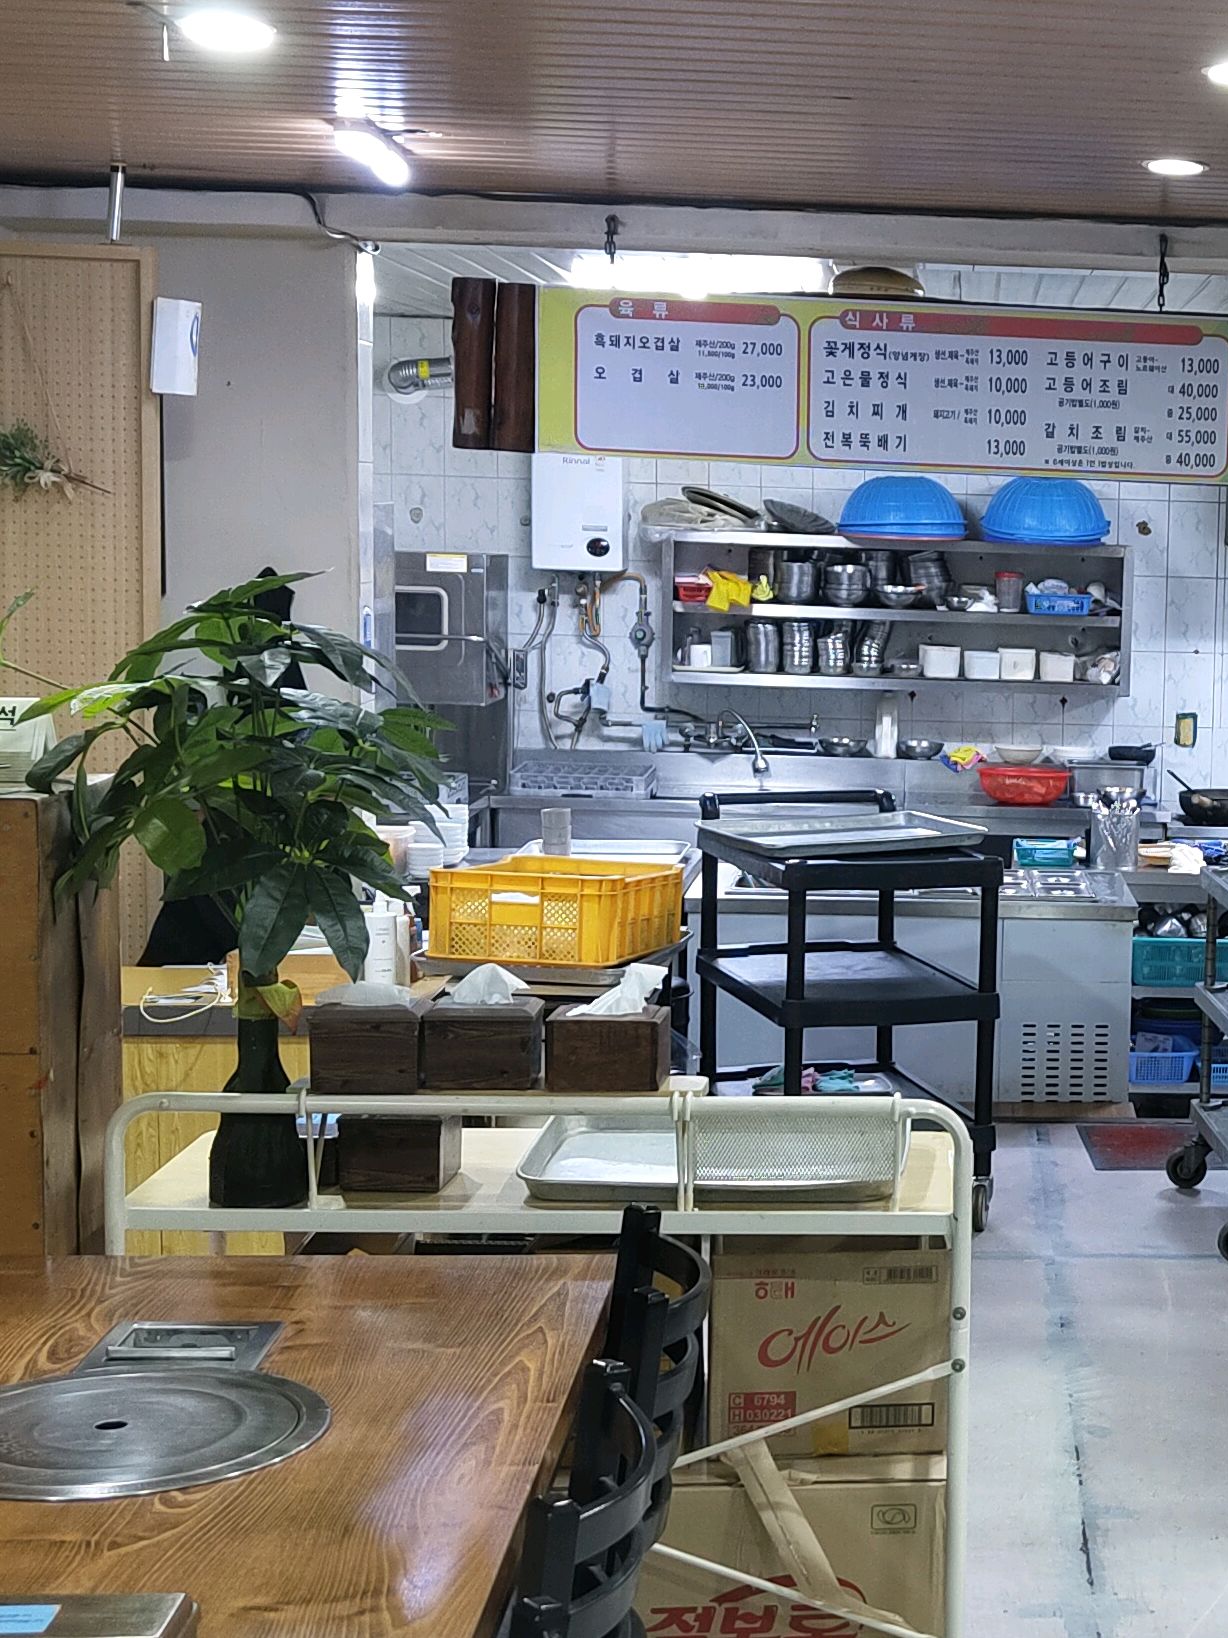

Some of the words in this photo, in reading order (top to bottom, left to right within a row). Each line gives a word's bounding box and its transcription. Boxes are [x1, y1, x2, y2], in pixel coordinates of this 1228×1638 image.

[594, 332, 680, 352] 흑돼지오겹살
[742, 341, 783, 357] 27,000
[990, 348, 1028, 366] 13,000
[1180, 358, 1220, 376] 13,000
[742, 373, 782, 390] 23,000
[988, 377, 1028, 395] 10,000
[1178, 382, 1218, 400] 40,000
[988, 408, 1026, 427] 10,000
[1178, 406, 1218, 422] 25,000
[1177, 430, 1216, 447] 55,000
[986, 439, 1026, 458] 13,000
[1176, 452, 1216, 470] 40,000
[758, 1305, 912, 1374] 에이스
[754, 1394, 786, 1406] 6794
[746, 1408, 792, 1420] 030221
